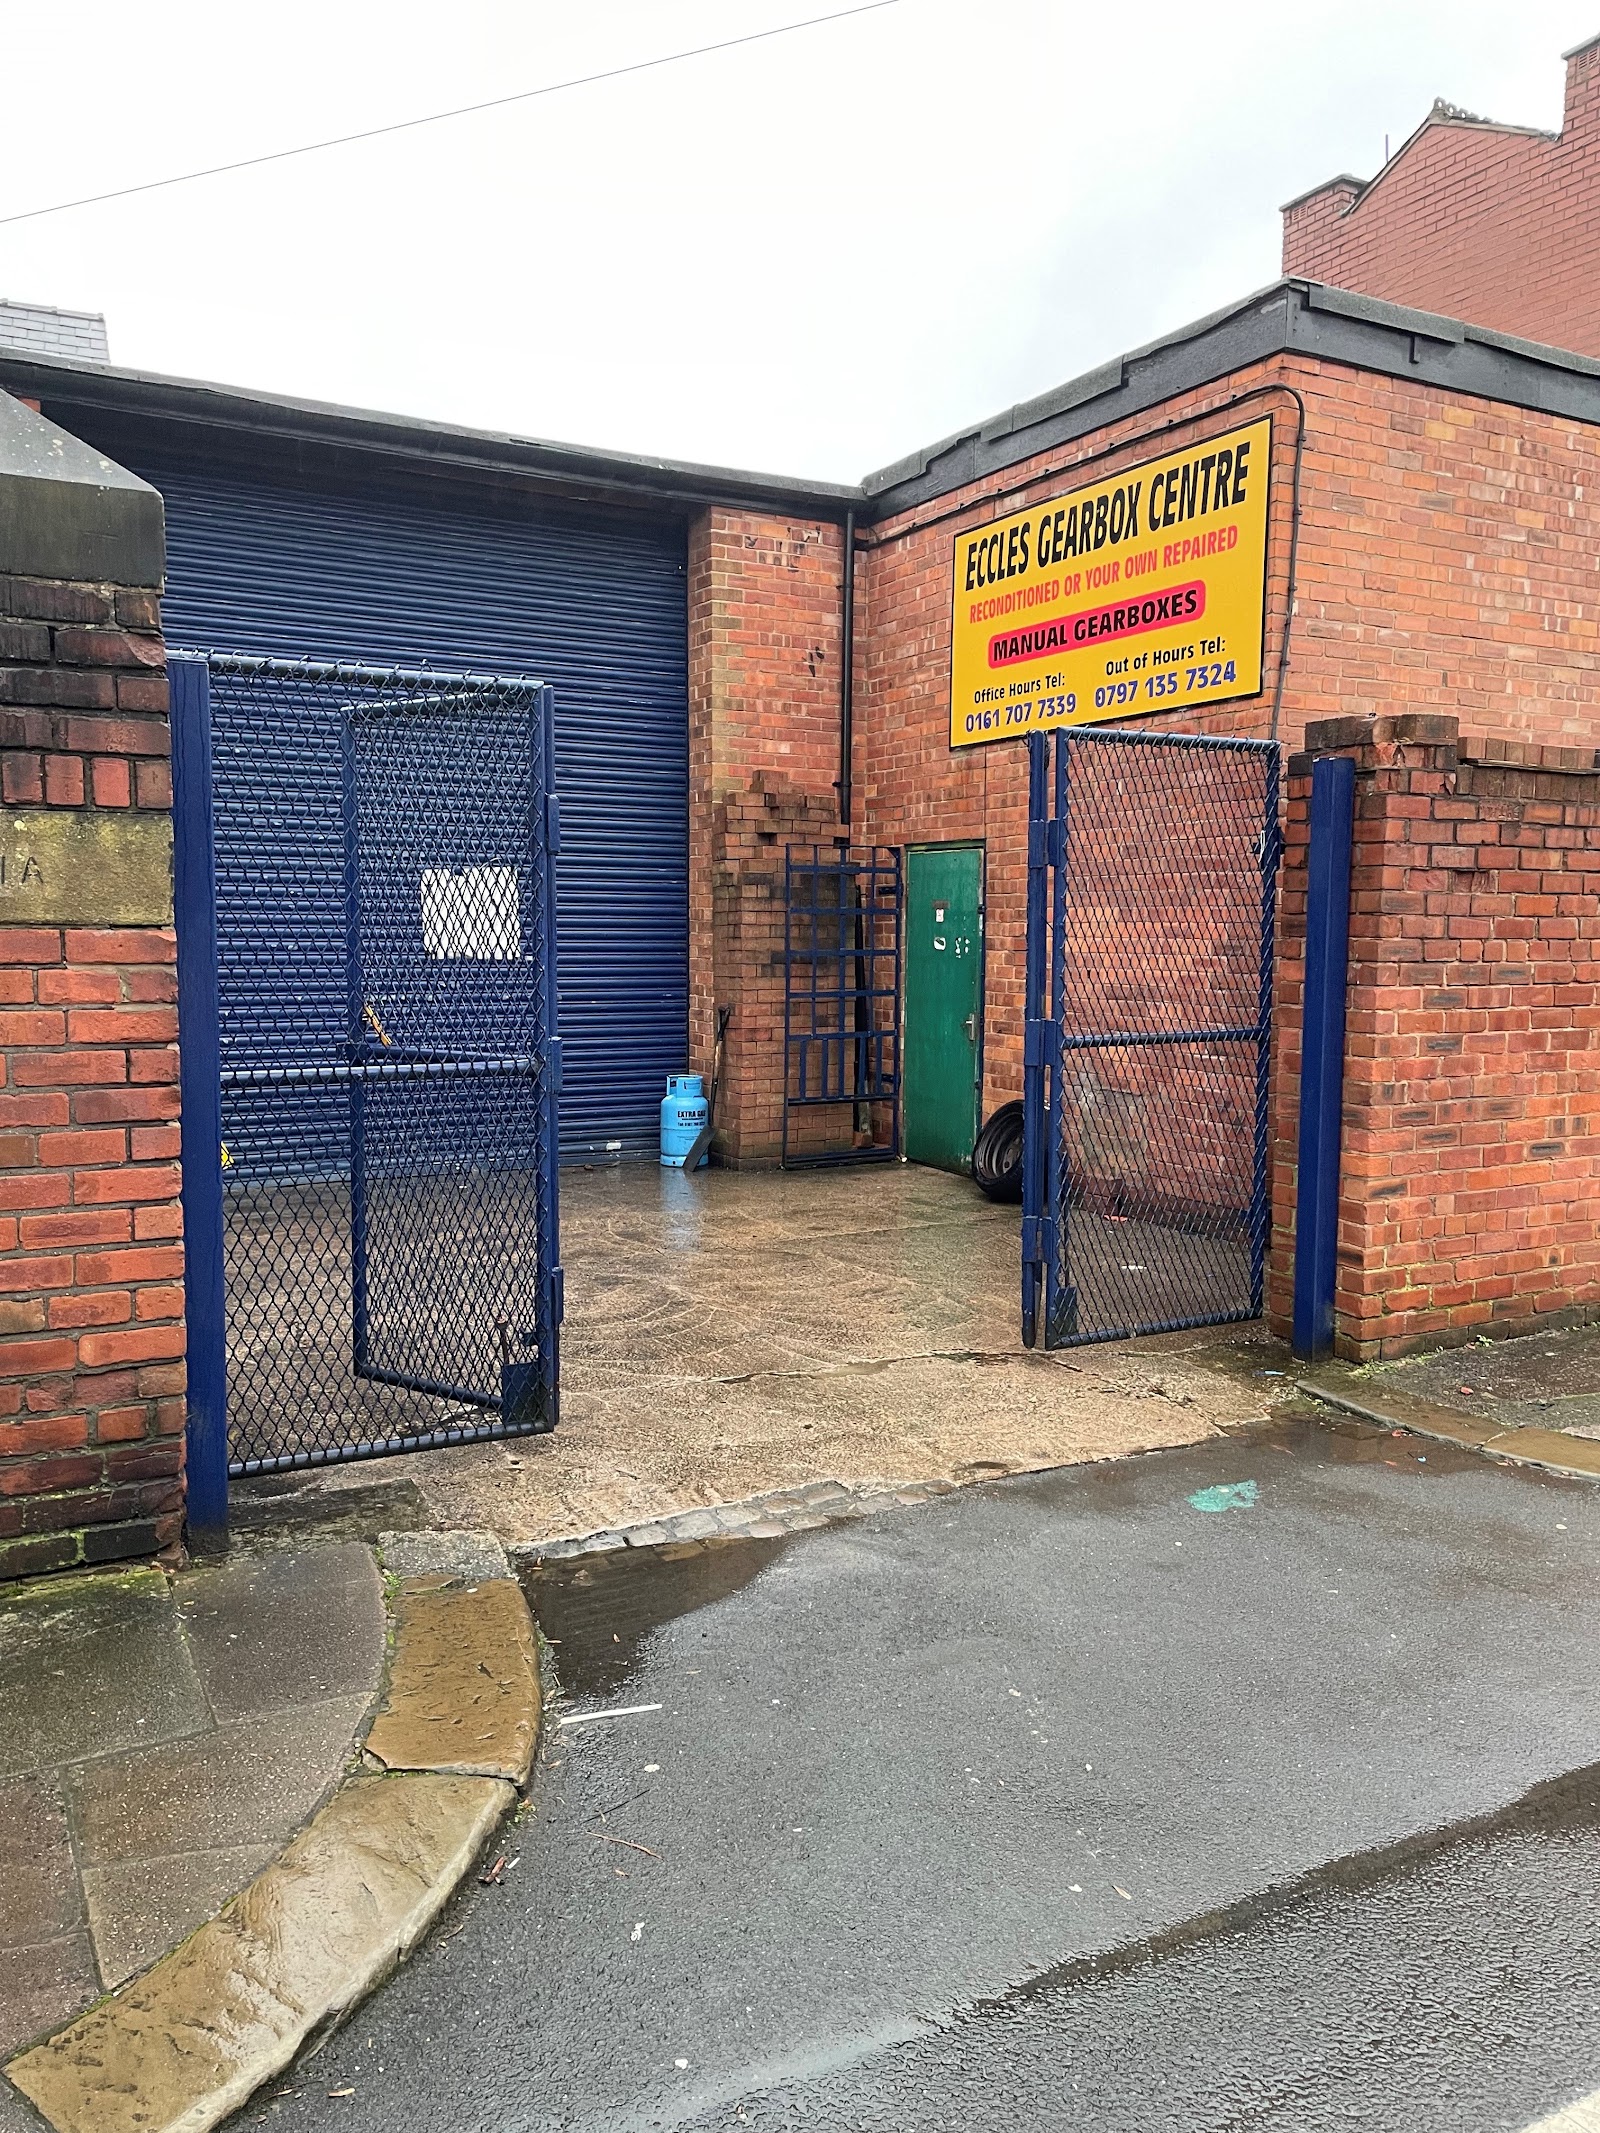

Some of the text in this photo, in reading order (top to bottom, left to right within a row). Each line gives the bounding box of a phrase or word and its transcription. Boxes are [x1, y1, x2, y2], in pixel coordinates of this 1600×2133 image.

[965, 441, 1250, 591] ECCLES GEARBOX CENTRE
[970, 525, 1238, 624] RECONDITIONED OR YOUR OWN REPAIRED
[993, 589, 1197, 661] MANUAL GEARBOXES
[1106, 636, 1226, 676] Out of Hours Tel:
[974, 672, 1065, 704] Office Hours Tel:
[1095, 660, 1236, 708] 0797 135 7324
[966, 693, 1076, 732] 0161 707 7339
